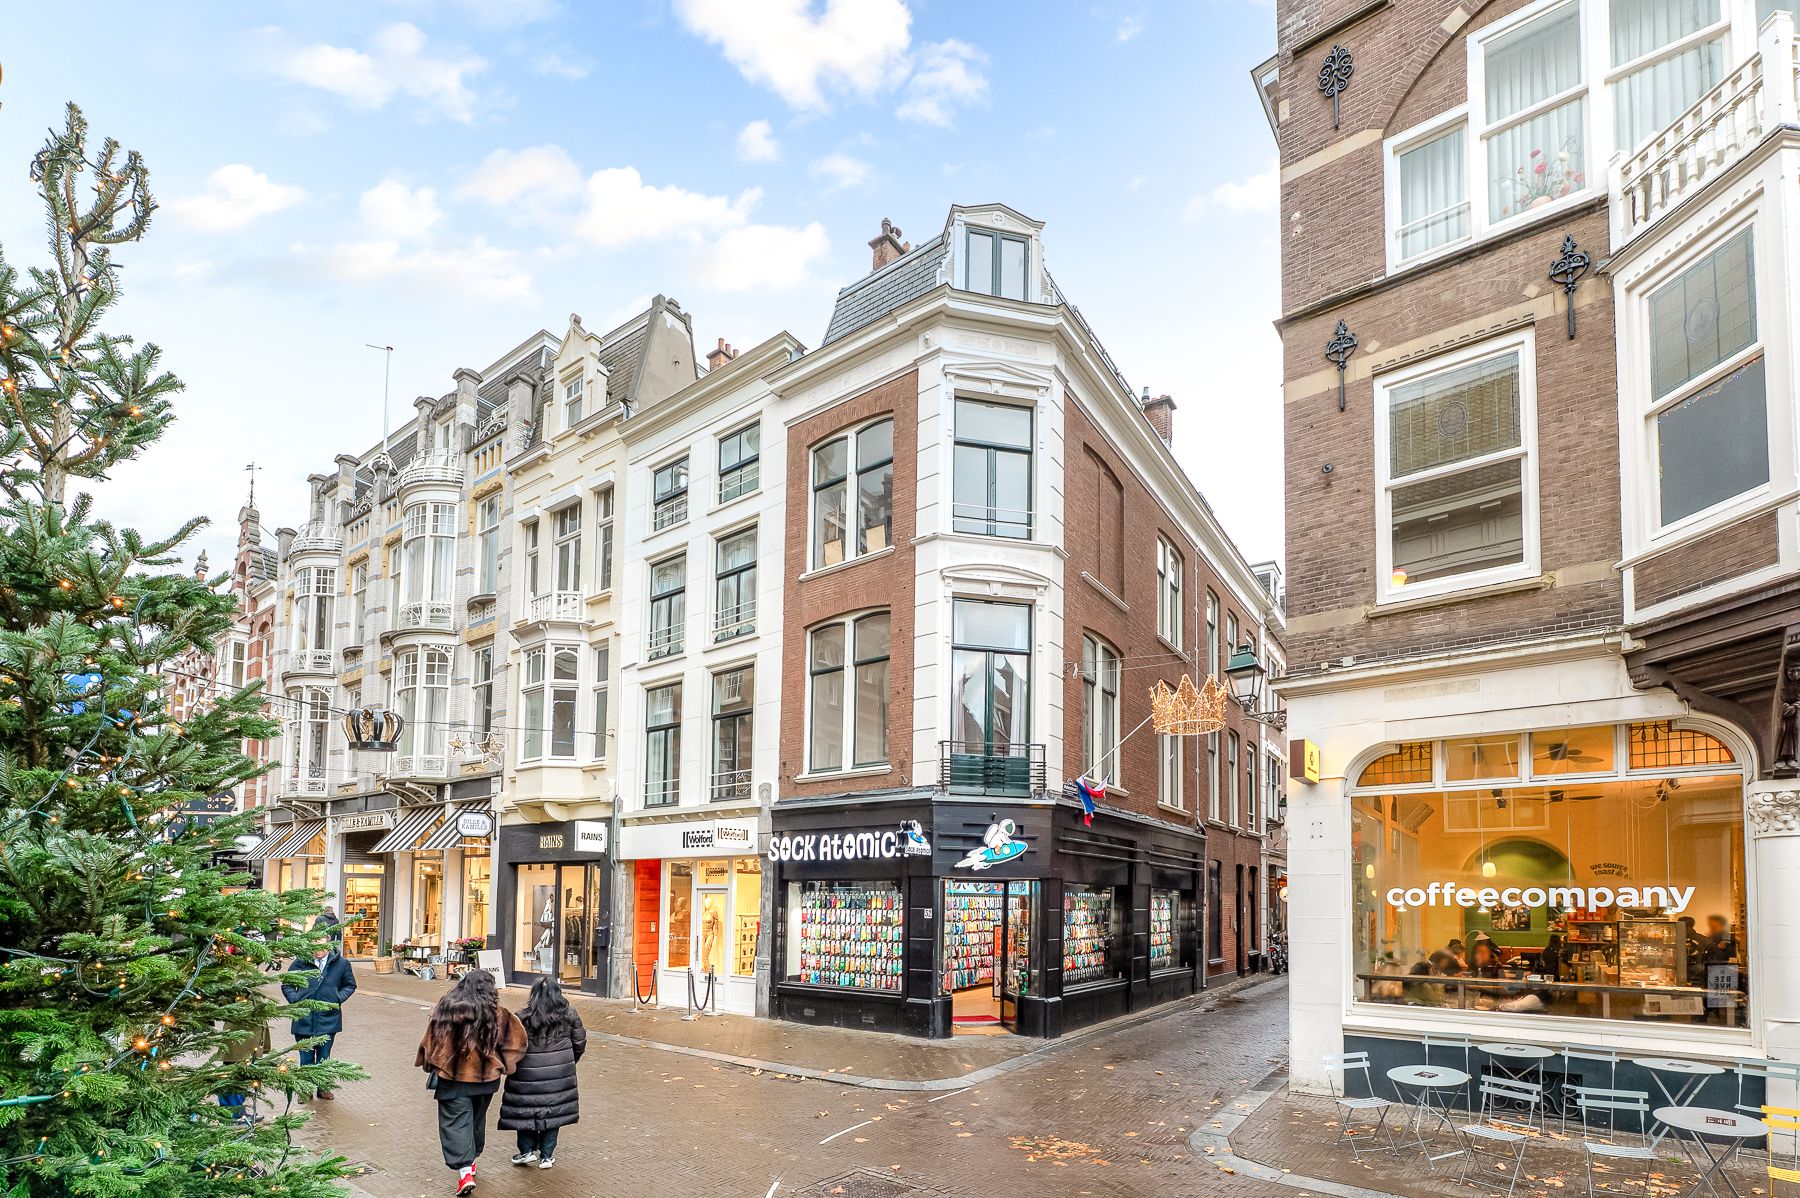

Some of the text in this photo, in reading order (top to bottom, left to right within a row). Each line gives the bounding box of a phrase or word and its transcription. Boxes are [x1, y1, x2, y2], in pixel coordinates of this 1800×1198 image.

[540, 834, 563, 848] RAINS
[581, 832, 603, 841] RAINS
[689, 833, 713, 844] Wolford
[767, 834, 816, 861] SOCK
[1602, 863, 1629, 872] source
[1386, 882, 1696, 913] coffeecompany
